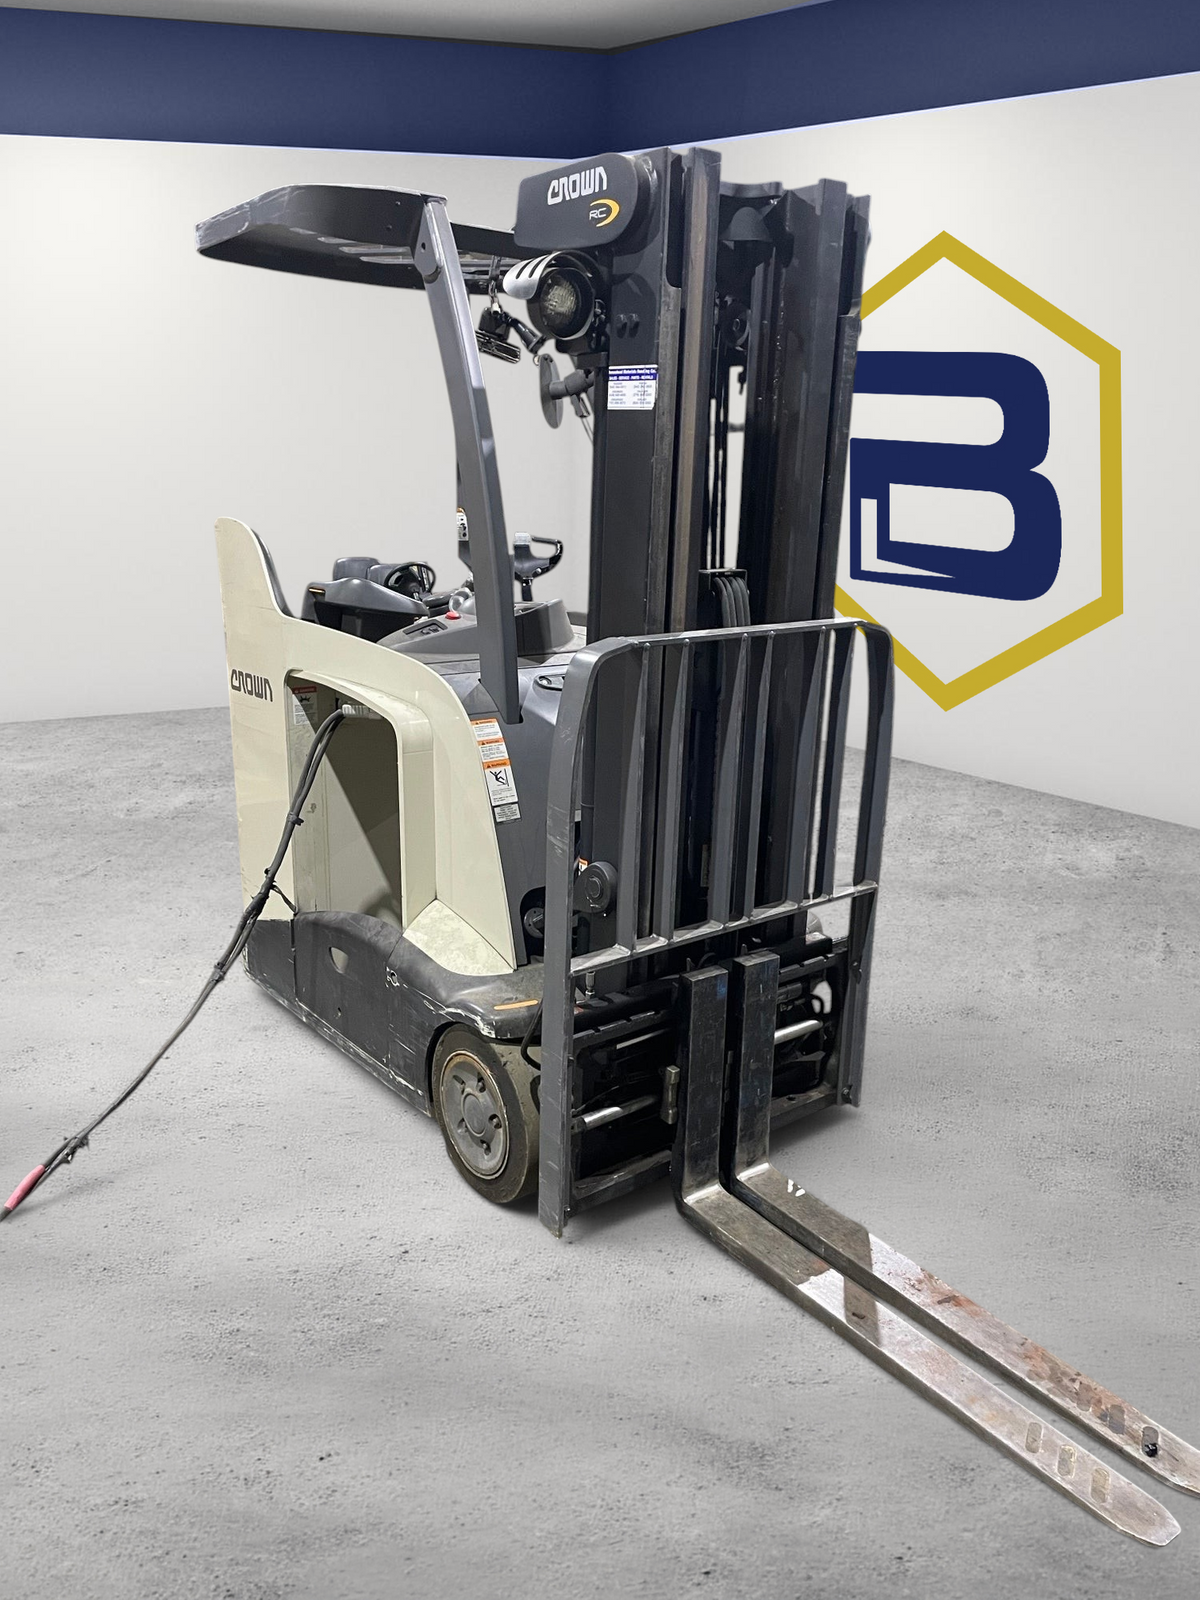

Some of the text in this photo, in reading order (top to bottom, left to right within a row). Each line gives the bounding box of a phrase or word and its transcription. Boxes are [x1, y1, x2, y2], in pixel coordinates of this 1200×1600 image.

[547, 166, 607, 206] CROWN
[589, 207, 607, 220] RC
[850, 351, 1062, 601] B
[230, 668, 273, 703] CROWN
